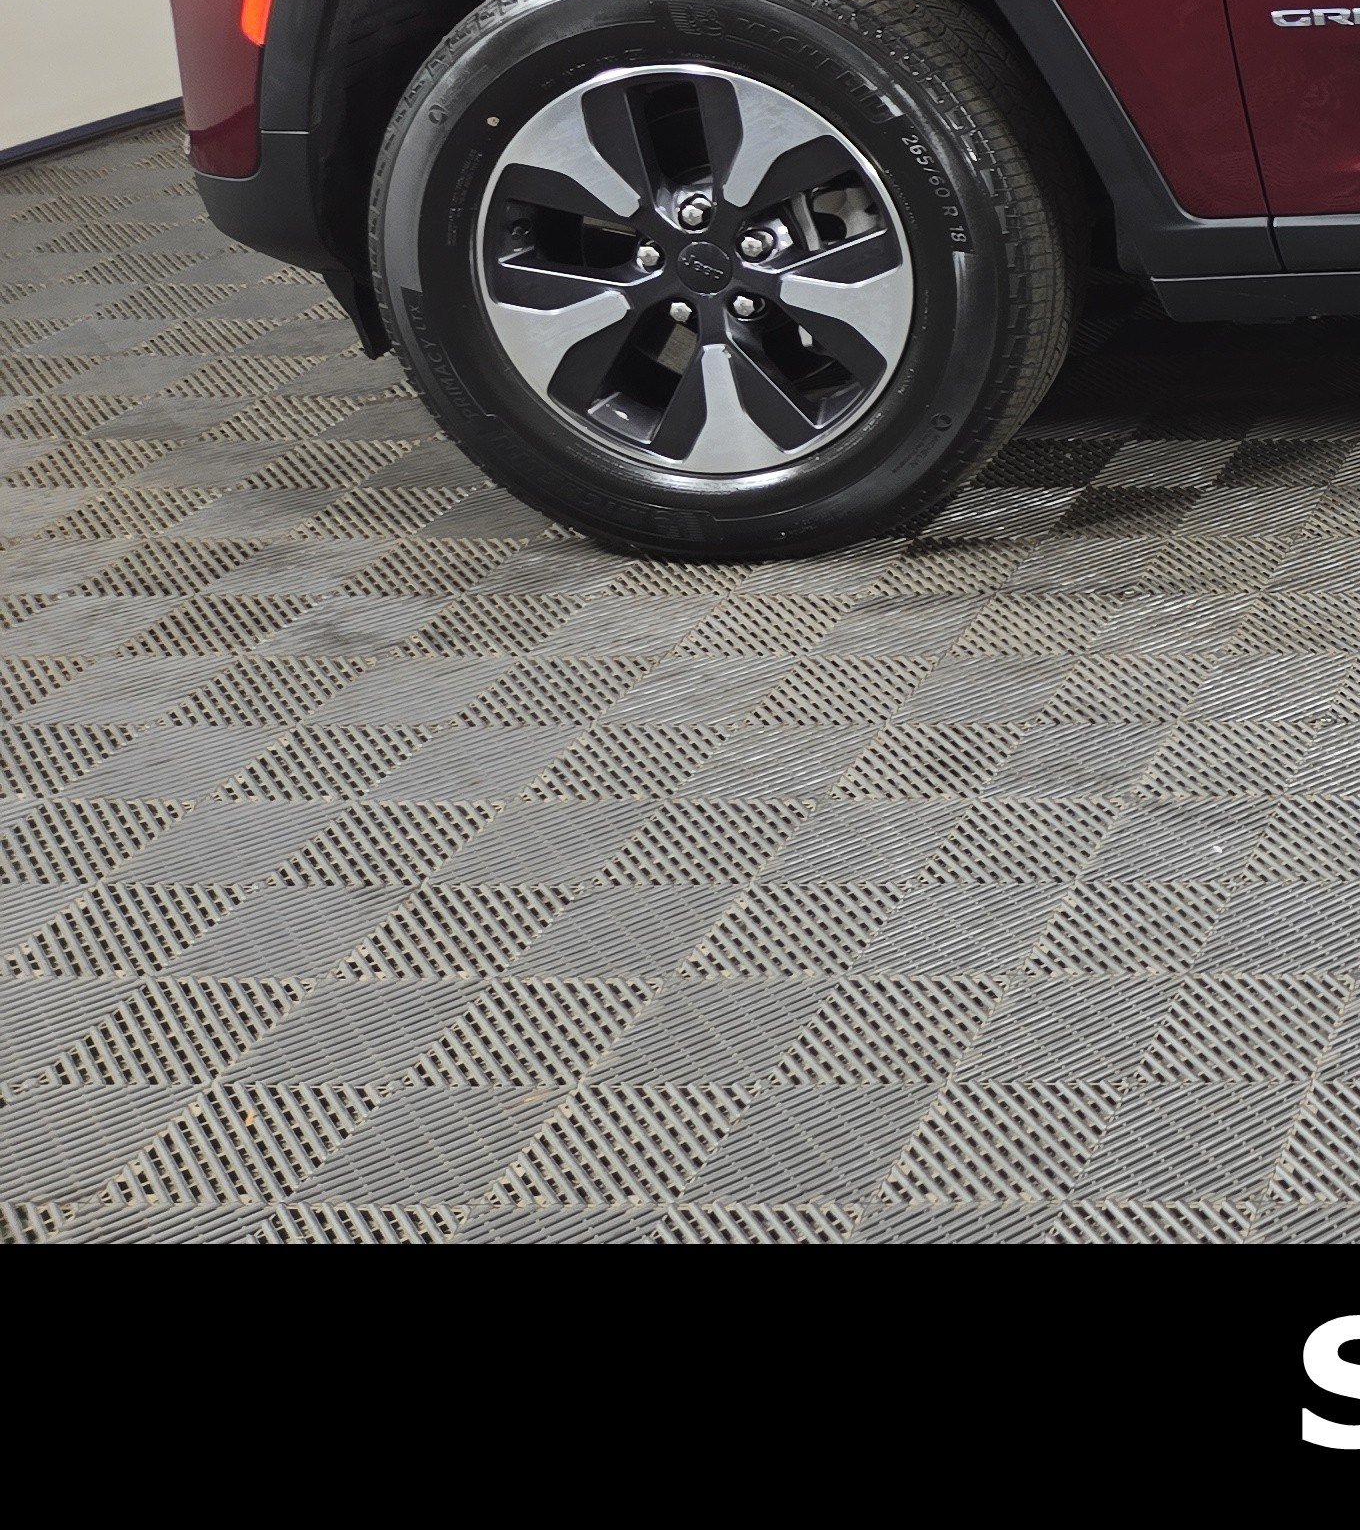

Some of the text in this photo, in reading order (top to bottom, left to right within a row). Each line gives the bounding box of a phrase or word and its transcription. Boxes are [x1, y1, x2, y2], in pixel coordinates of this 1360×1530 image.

[901, 133, 968, 243] 265/60 R 18
[408, 303, 481, 419] PRIMACY LTX
